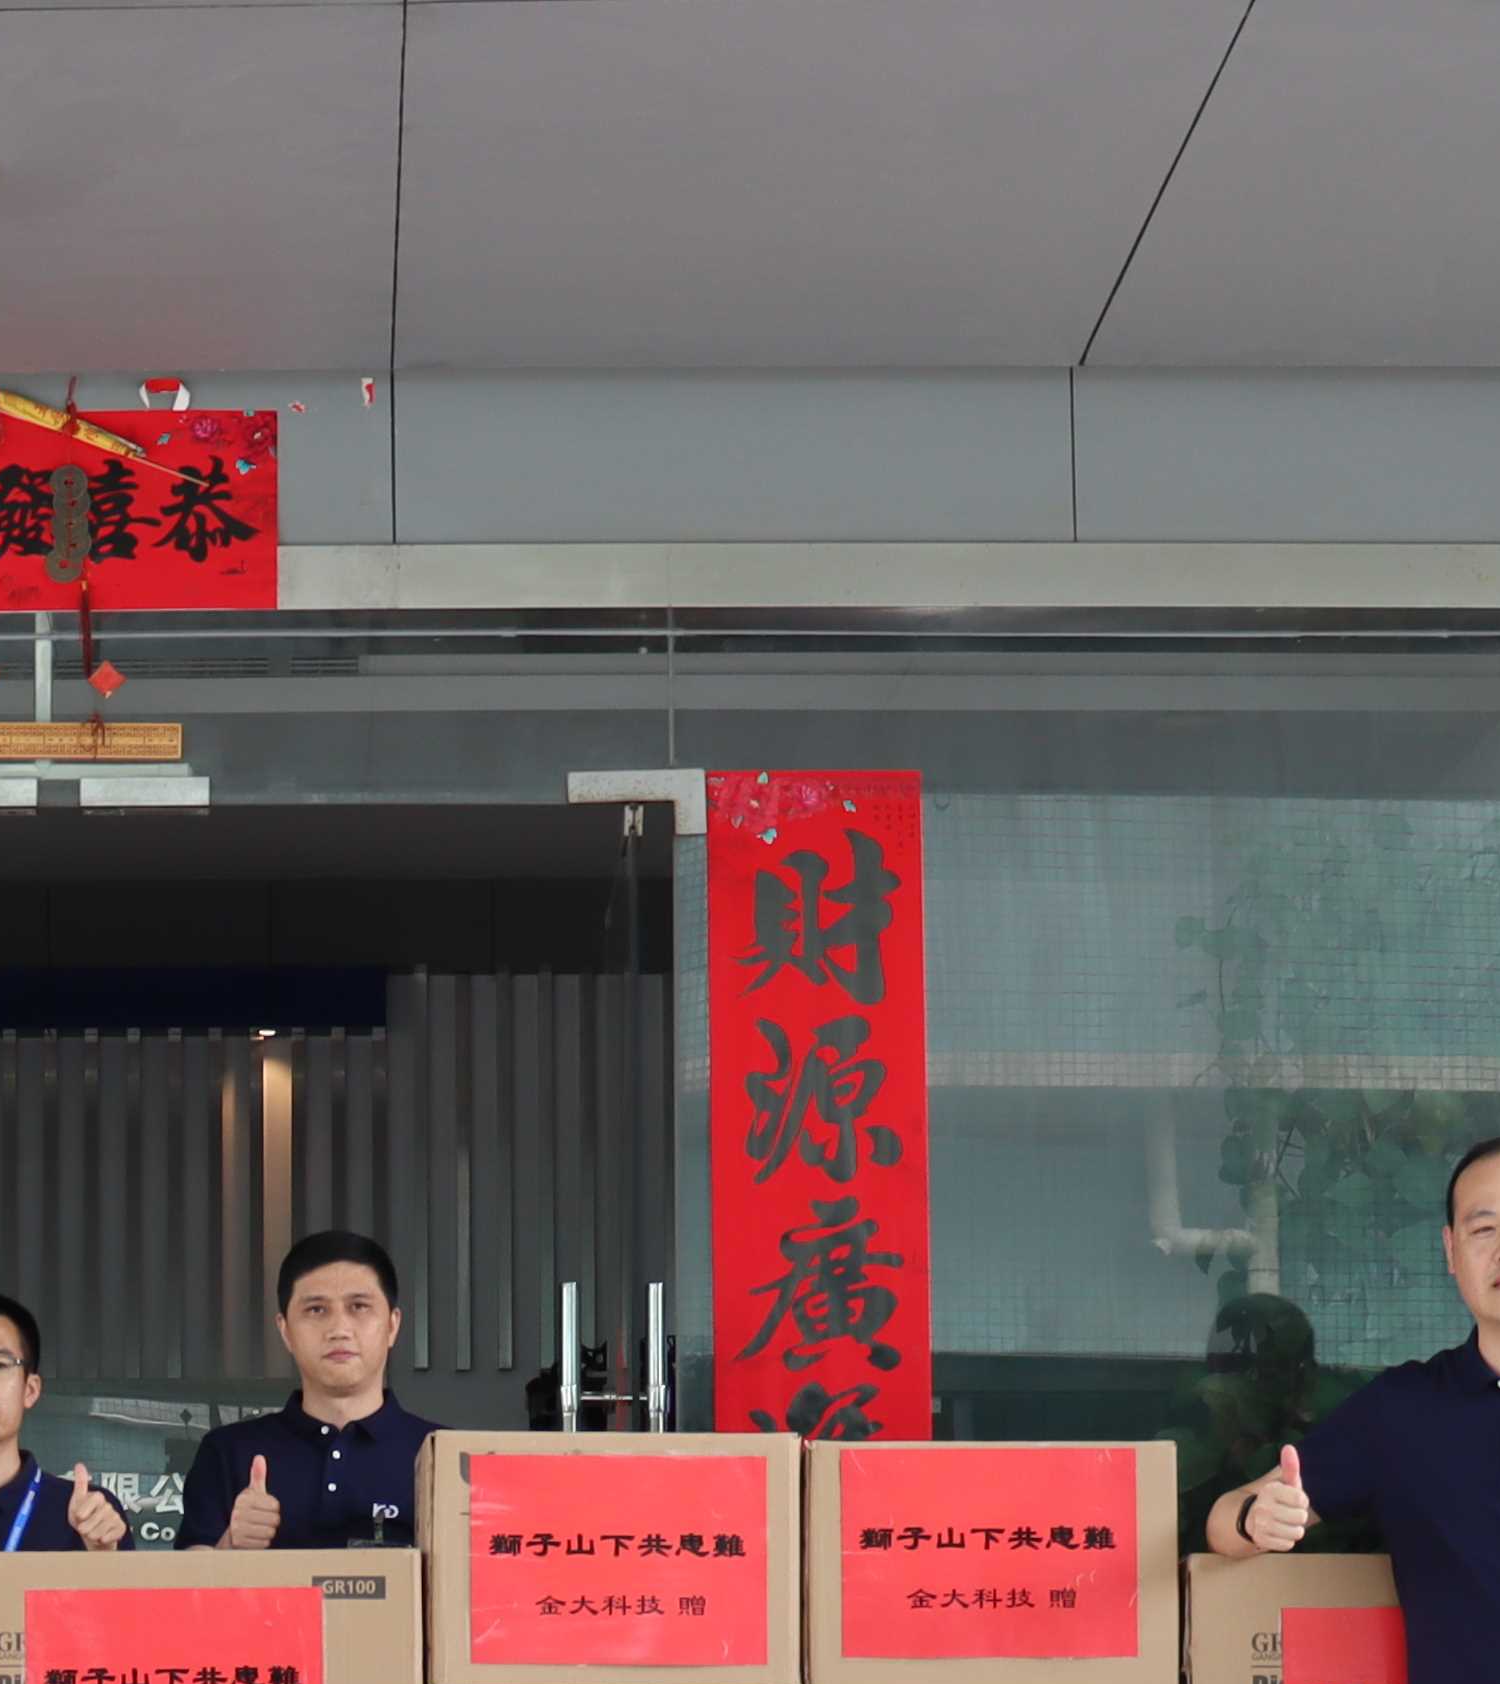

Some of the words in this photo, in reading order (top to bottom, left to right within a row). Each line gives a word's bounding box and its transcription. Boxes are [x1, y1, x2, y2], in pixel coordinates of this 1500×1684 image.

[321, 1579, 376, 1596] GR100
[536, 1595, 665, 1616] 金大科技
[906, 1588, 1035, 1609] 金大科技
